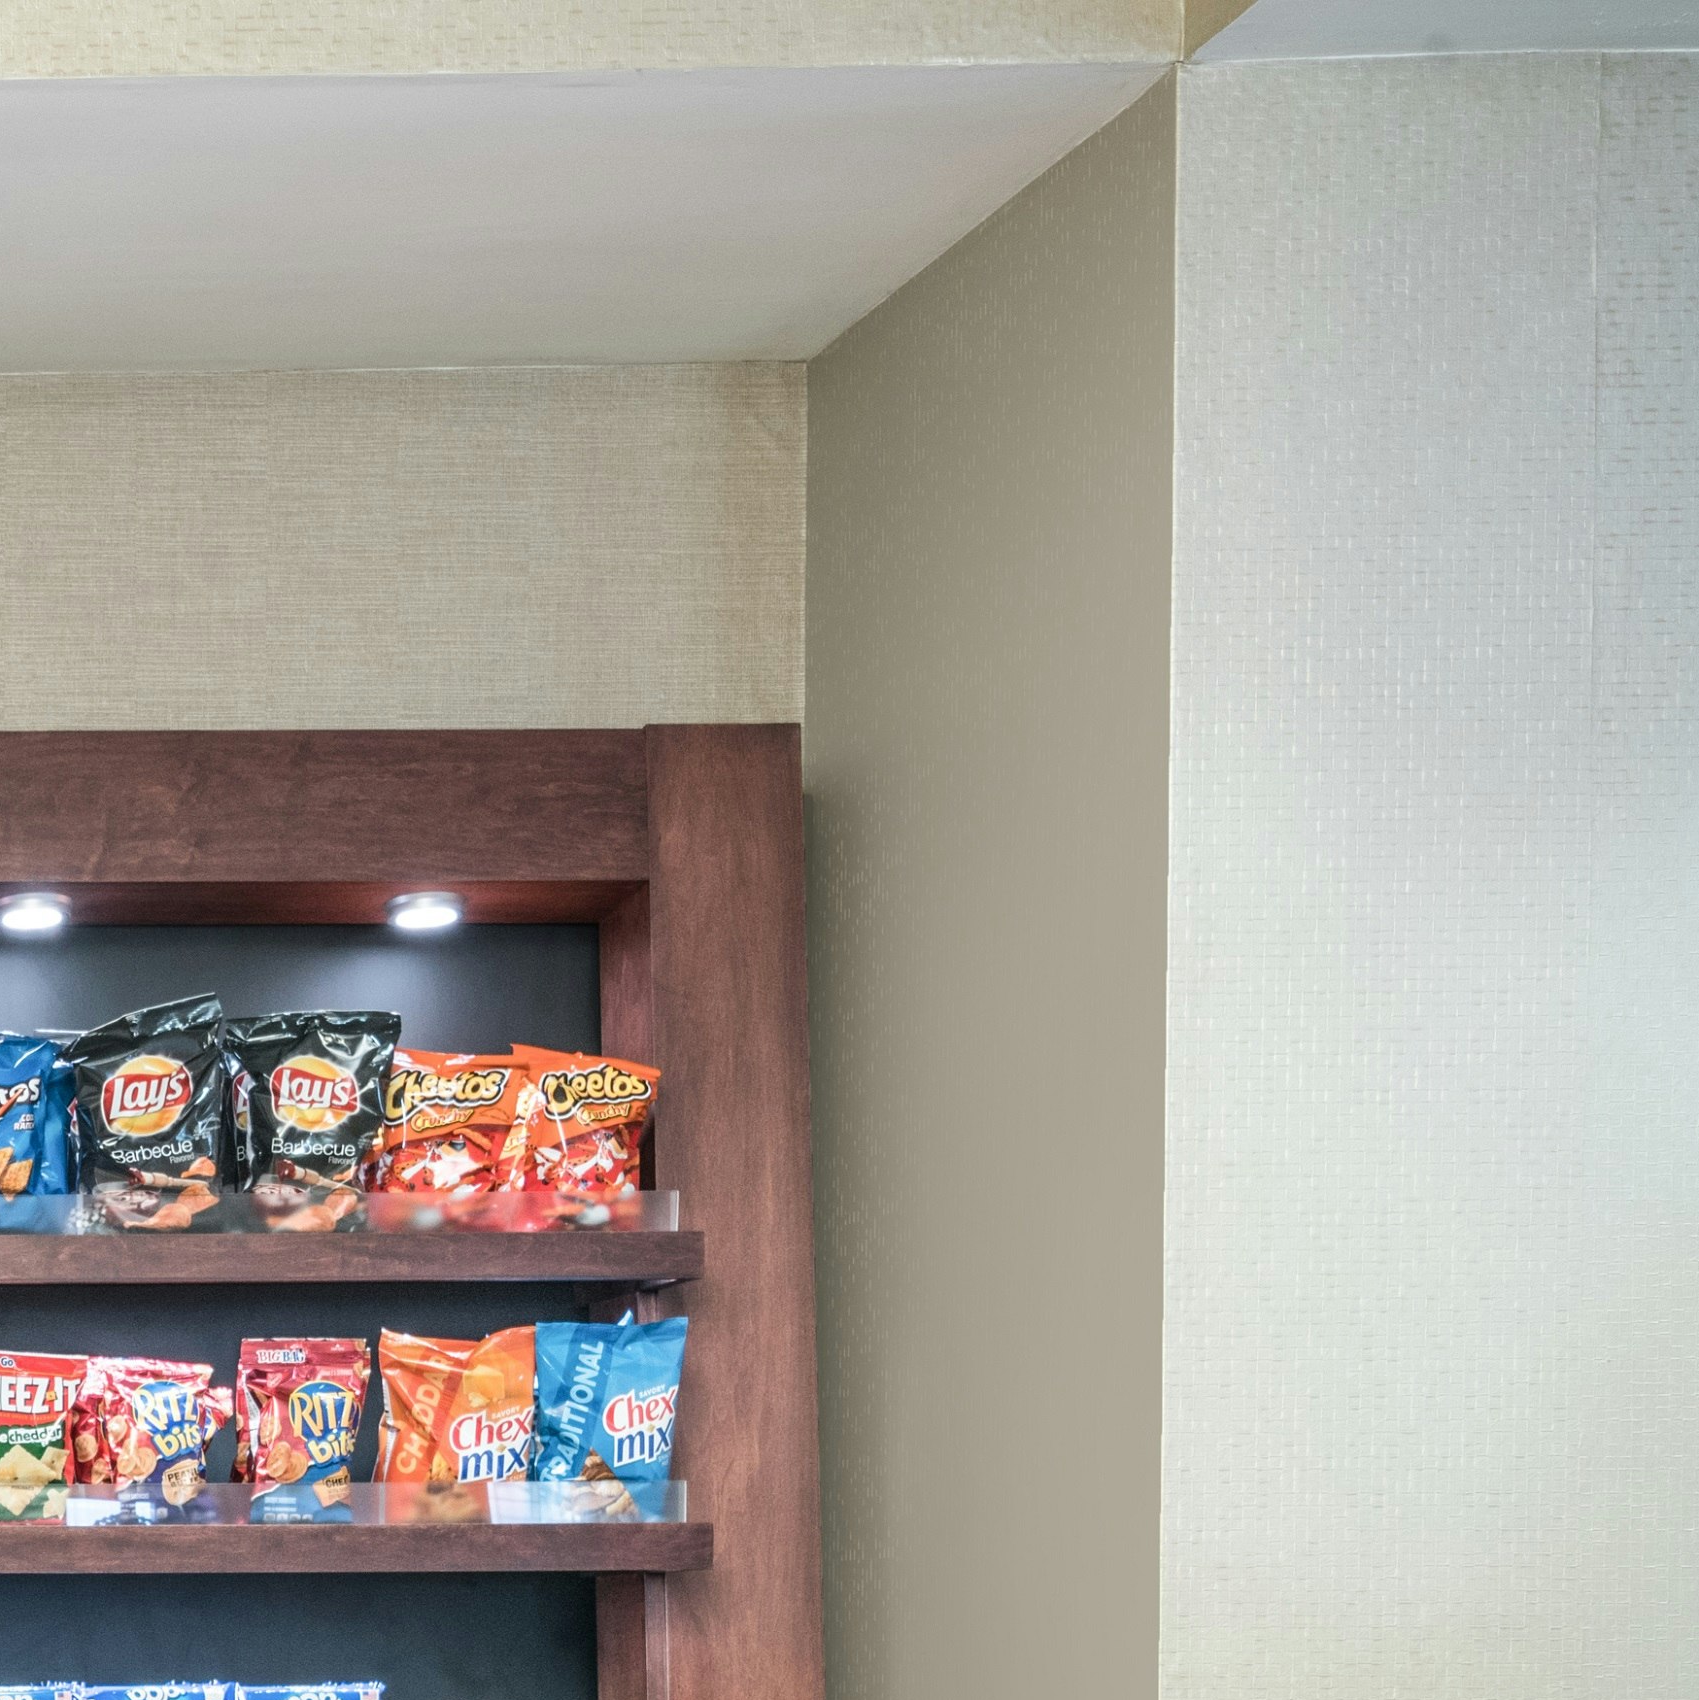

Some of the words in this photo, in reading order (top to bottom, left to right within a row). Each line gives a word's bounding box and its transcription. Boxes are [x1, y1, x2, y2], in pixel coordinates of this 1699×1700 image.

[108, 1070, 187, 1120] Lay's
[278, 1068, 352, 1111] Lay's
[384, 1068, 505, 1124] Cheetos
[543, 1065, 650, 1118] Cheetos
[410, 1108, 473, 1132] Crunchy
[576, 1103, 630, 1125] Crunchy
[112, 1139, 193, 1164] Barbecue
[169, 1153, 195, 1164] Flavored
[271, 1138, 356, 1157] Barbecue
[0, 1356, 14, 1367] Go
[256, 1350, 281, 1364] BIG
[281, 1350, 307, 1364] BAG
[133, 1387, 200, 1430] RITZ
[604, 1386, 679, 1434] Chex
[638, 1383, 668, 1399] SAVORY
[289, 1391, 355, 1437] RITZ
[451, 1405, 534, 1449] Chex
[490, 1405, 522, 1421] SAVORY
[539, 1340, 605, 1482] TRADITIONAL
[154, 1422, 202, 1456] bits
[308, 1432, 355, 1463] bits
[614, 1418, 673, 1466] mix
[459, 1438, 531, 1482] mix
